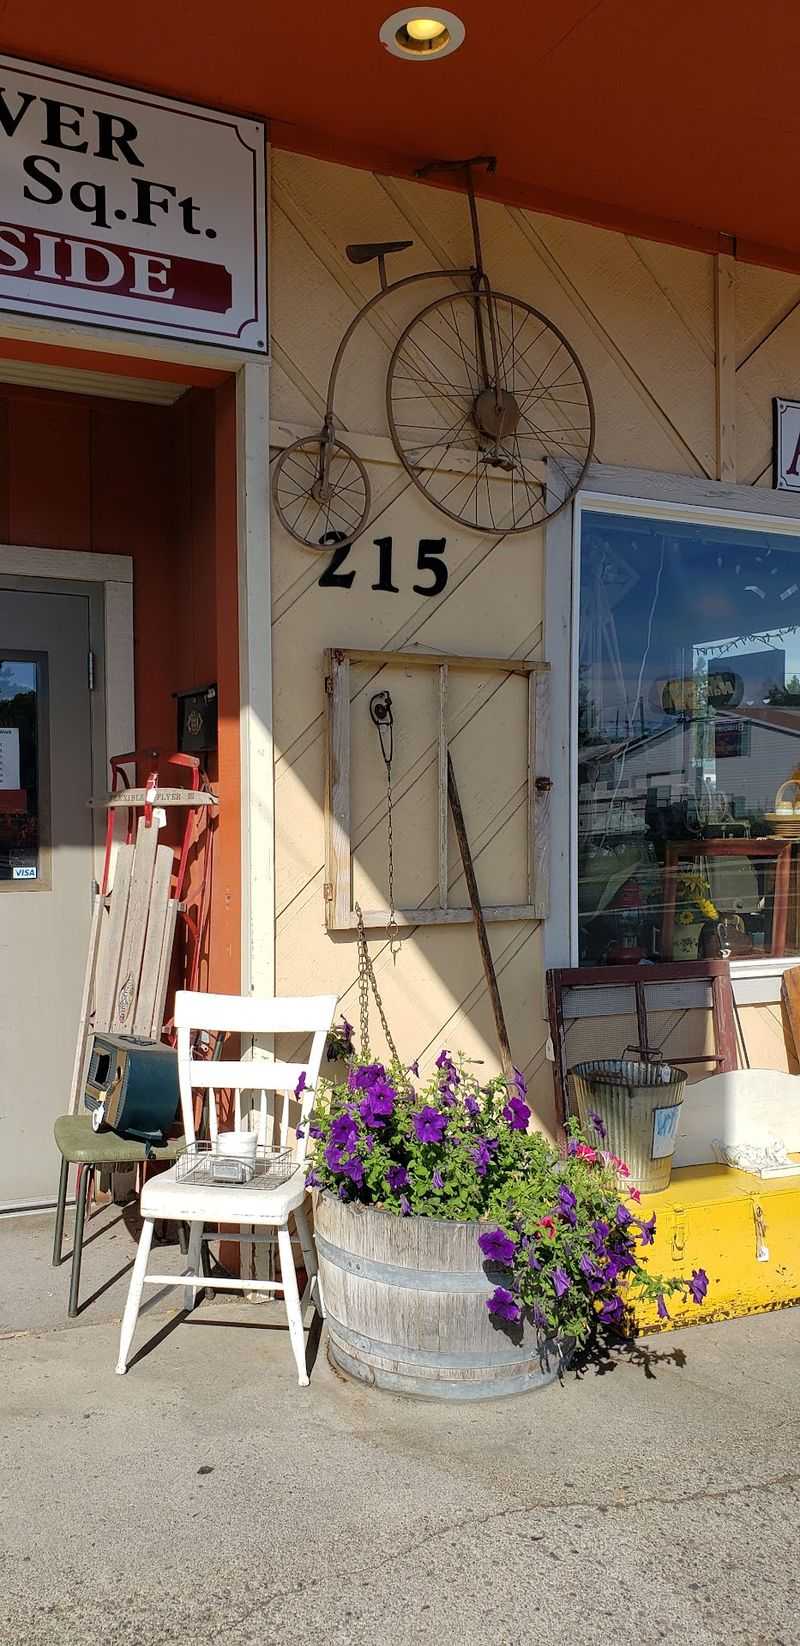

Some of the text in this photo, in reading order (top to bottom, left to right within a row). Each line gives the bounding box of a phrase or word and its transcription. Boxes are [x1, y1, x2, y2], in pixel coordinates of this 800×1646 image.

[0, 86, 144, 168] VER
[23, 154, 217, 239] Sq.Ft.
[0, 226, 175, 300] SIDE
[318, 530, 448, 597] 215
[15, 869, 35, 877] VISA
